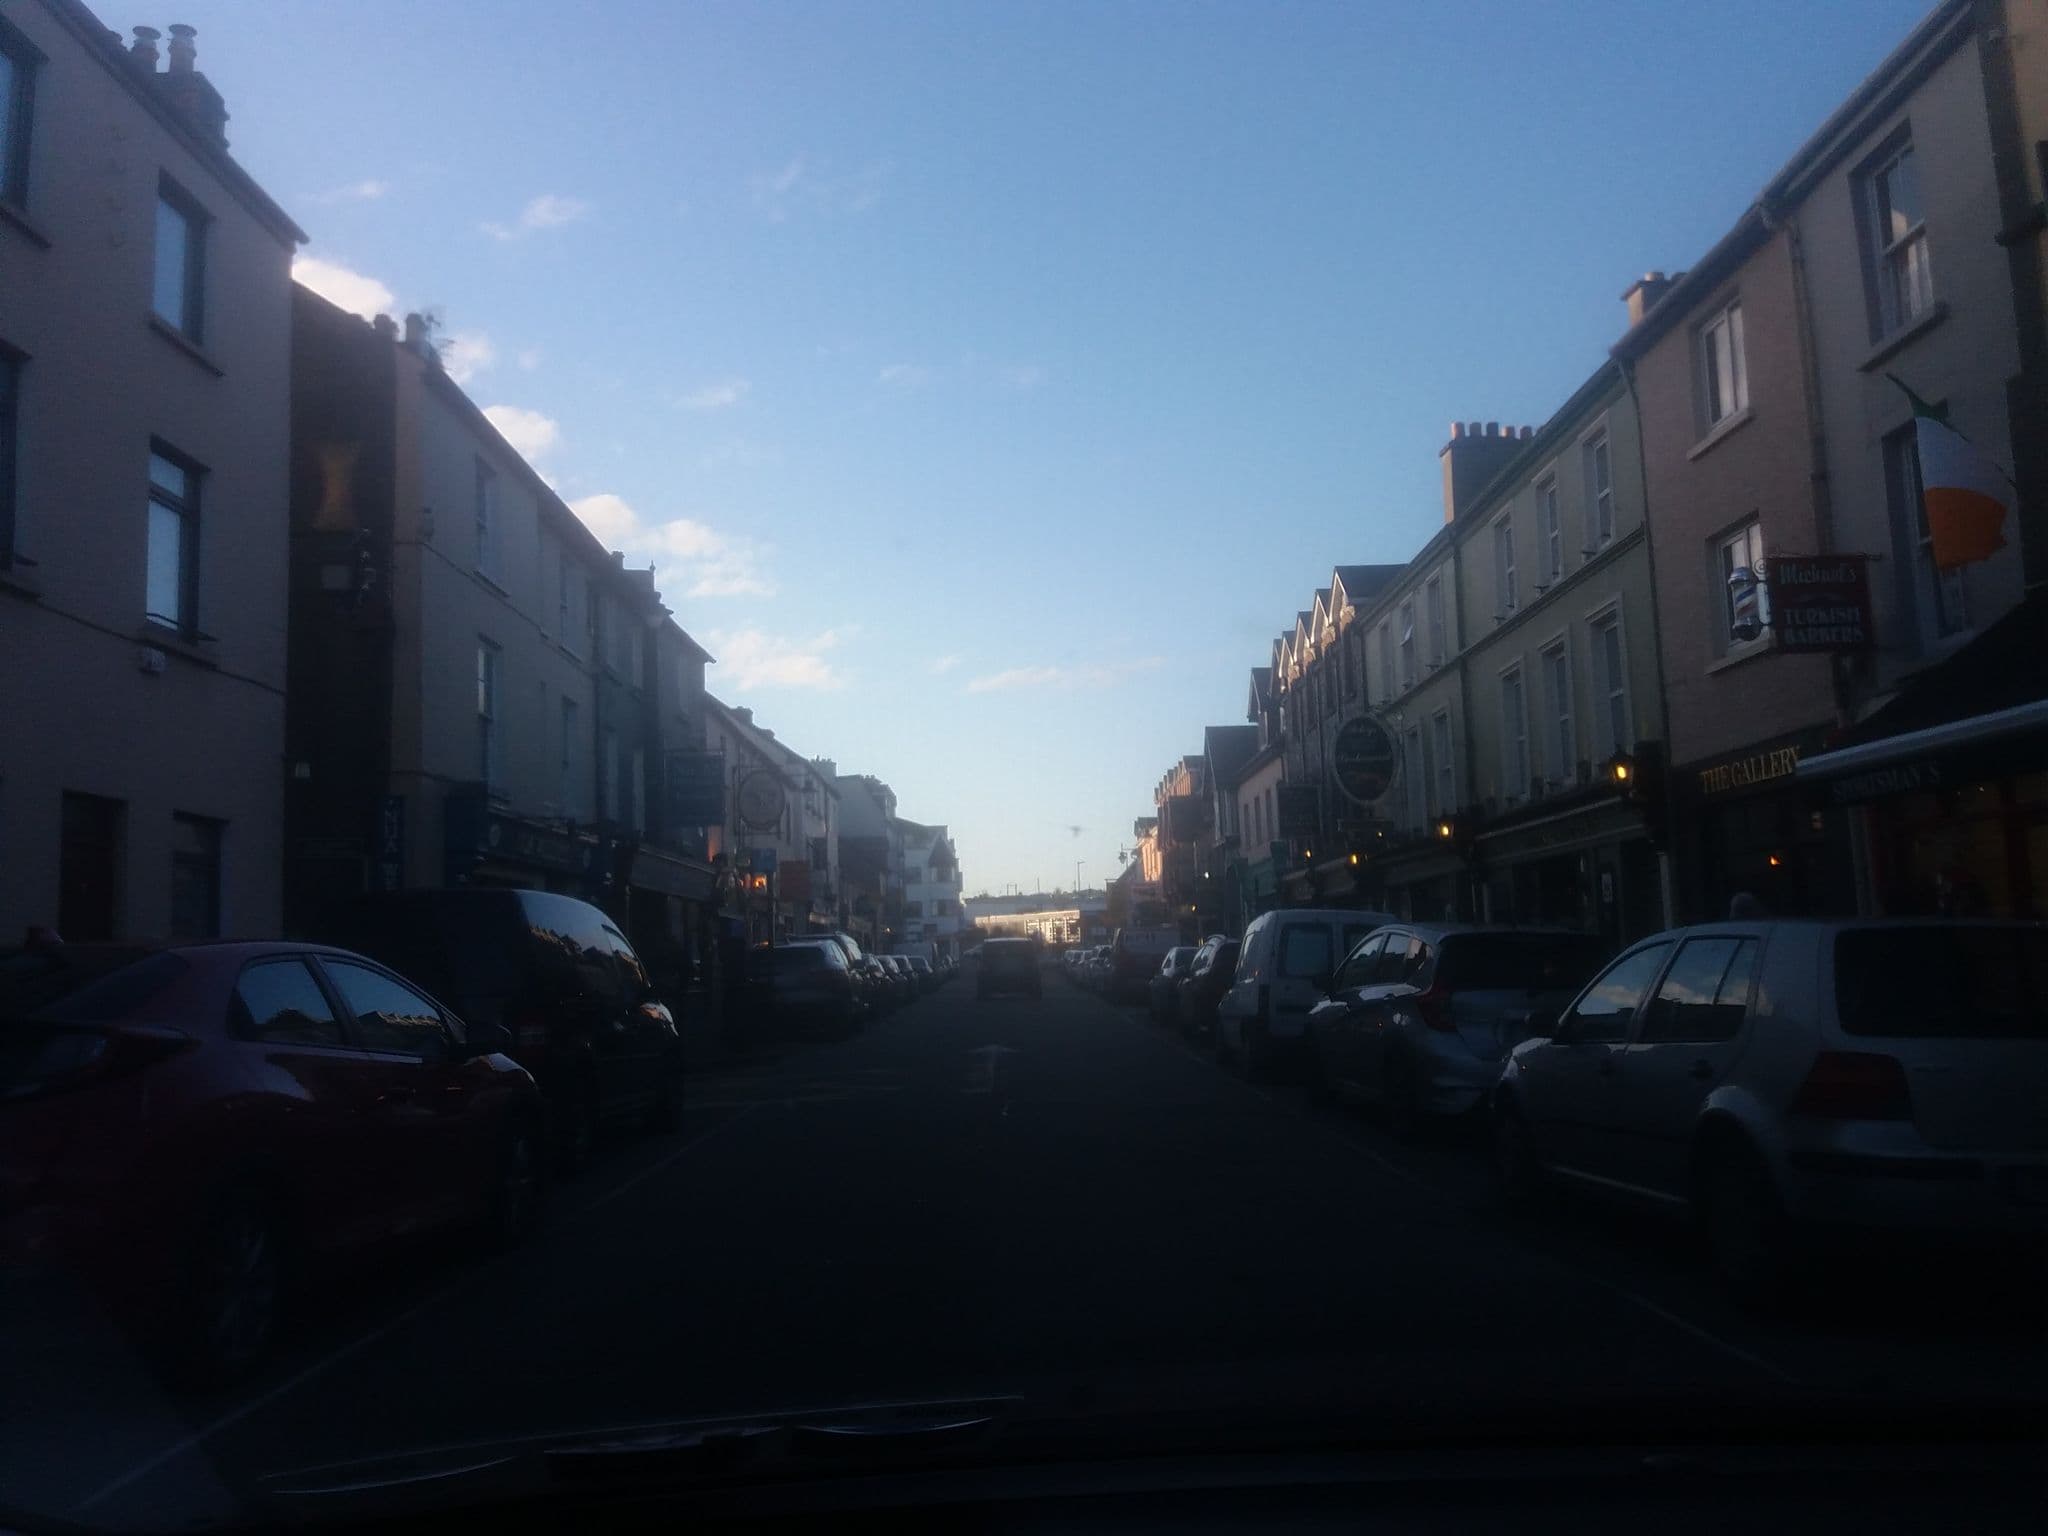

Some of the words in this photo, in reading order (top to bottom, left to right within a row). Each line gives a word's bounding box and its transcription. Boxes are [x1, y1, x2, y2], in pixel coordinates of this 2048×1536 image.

[1784, 608, 1862, 625] TURKISH
[1784, 626, 1864, 645] BARBERS
[1731, 745, 1800, 786] GALLERY
[1700, 766, 1730, 794] THE
